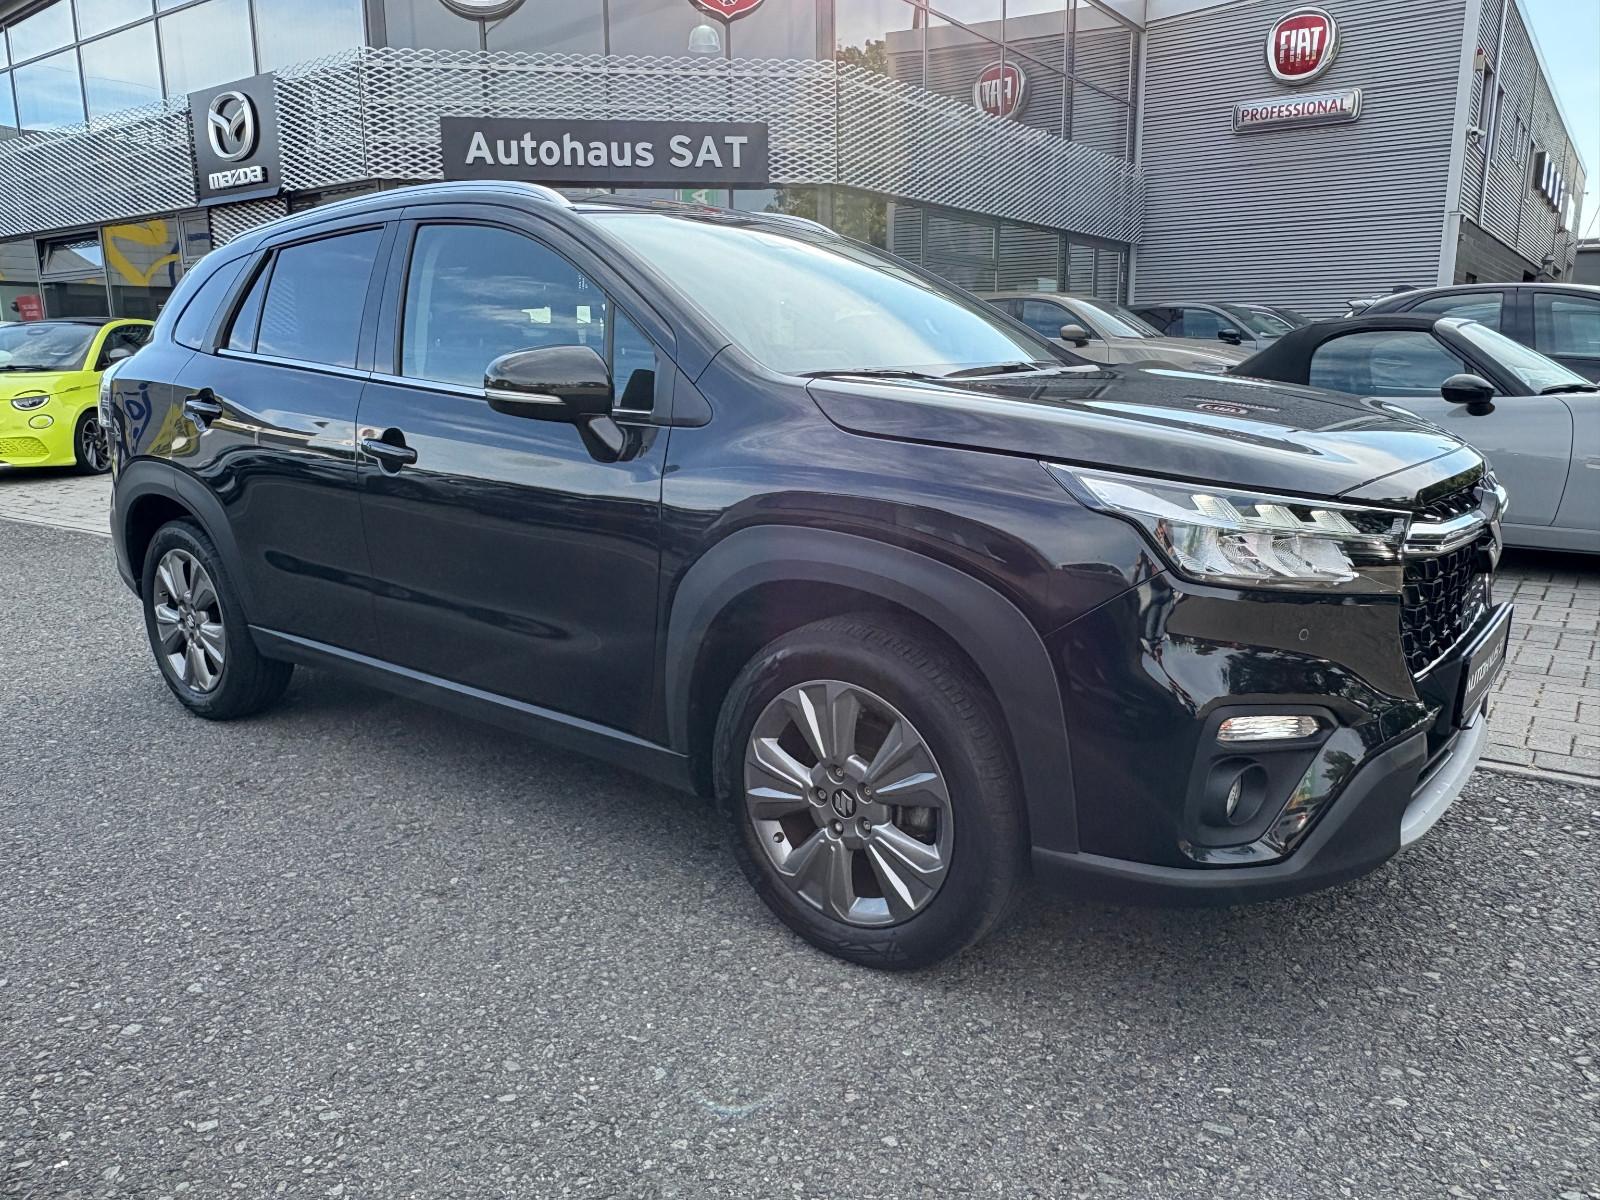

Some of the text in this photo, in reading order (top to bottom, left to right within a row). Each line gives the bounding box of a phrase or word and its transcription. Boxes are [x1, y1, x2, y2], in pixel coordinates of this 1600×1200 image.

[1279, 26, 1323, 63] FIAT
[1241, 98, 1346, 122] PROFESSIONAL
[465, 132, 749, 168] Autohaus SAT
